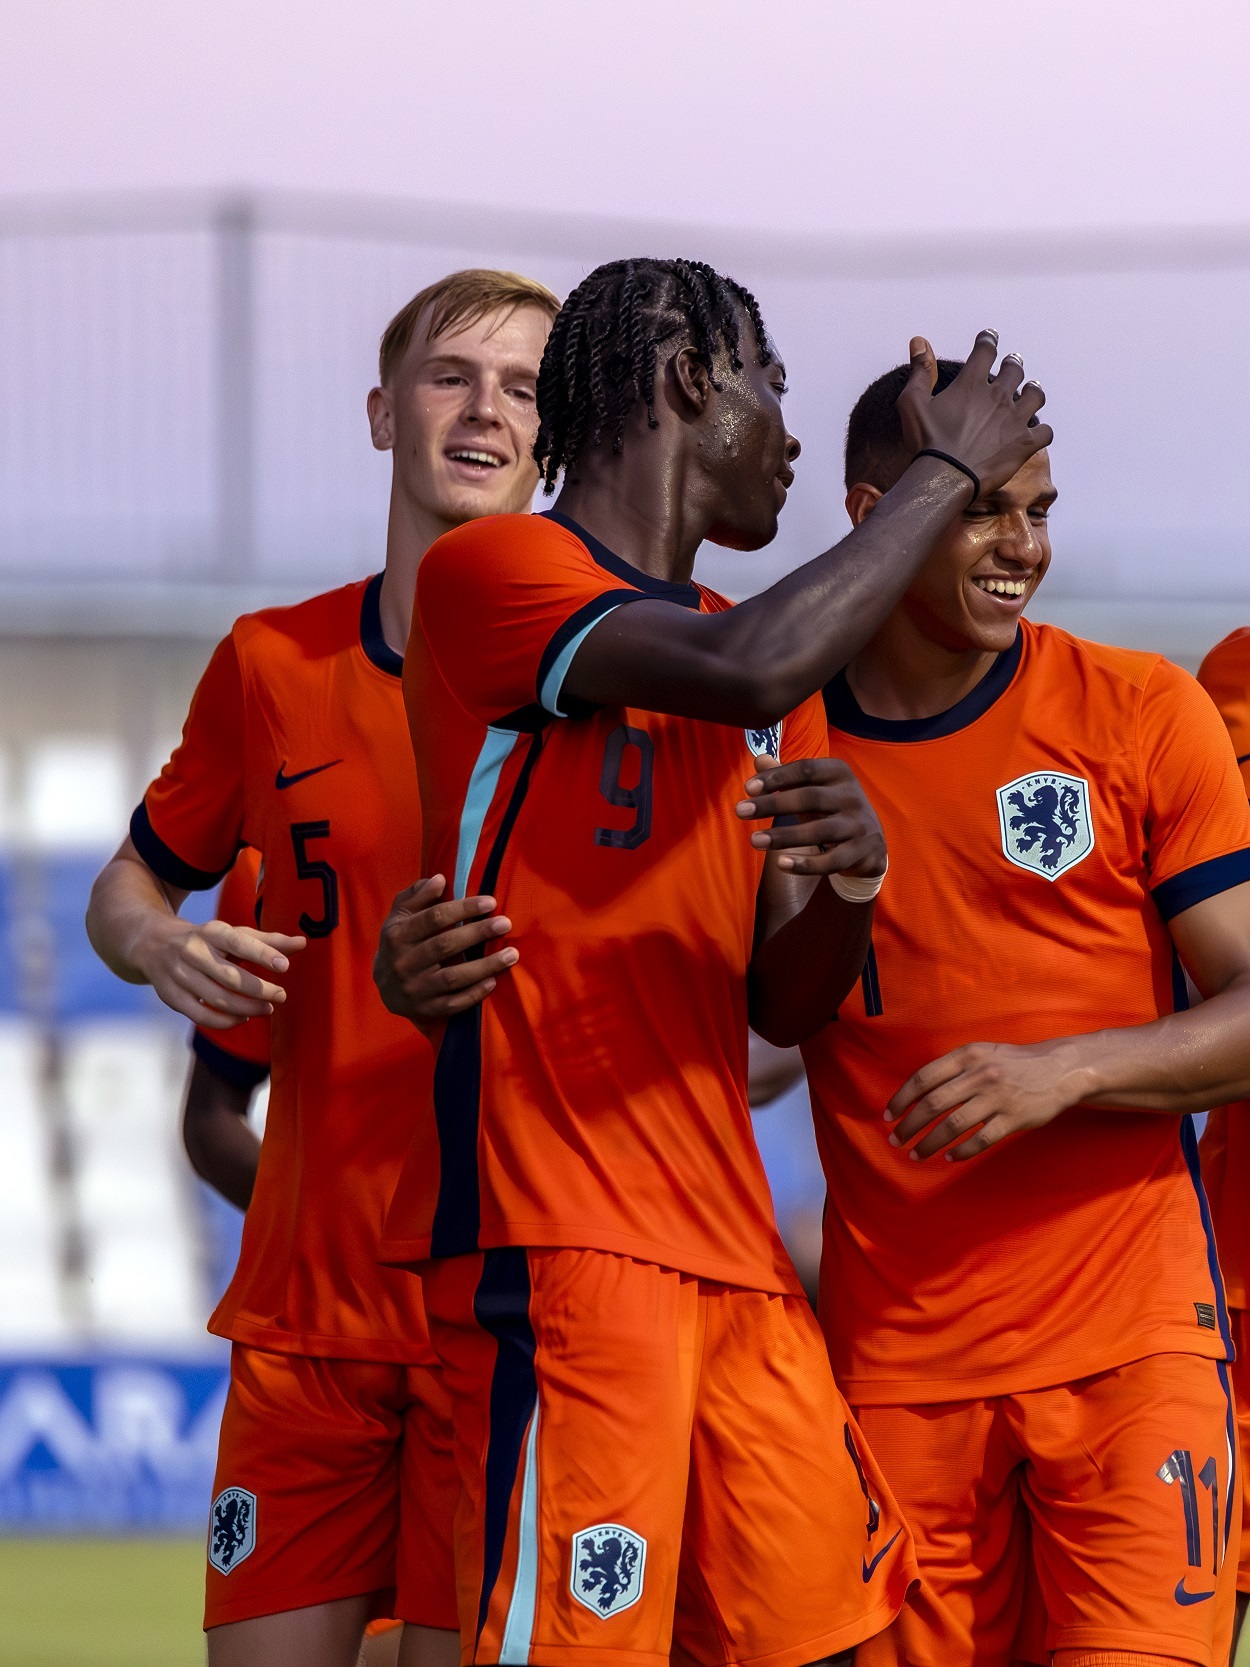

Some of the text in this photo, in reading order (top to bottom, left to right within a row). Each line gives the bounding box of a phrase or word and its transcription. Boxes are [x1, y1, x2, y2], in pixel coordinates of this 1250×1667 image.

[593, 724, 656, 851] 9
[1025, 777, 1058, 788] KNVB
[289, 819, 339, 939] 5
[1155, 1449, 1219, 1577] 11
